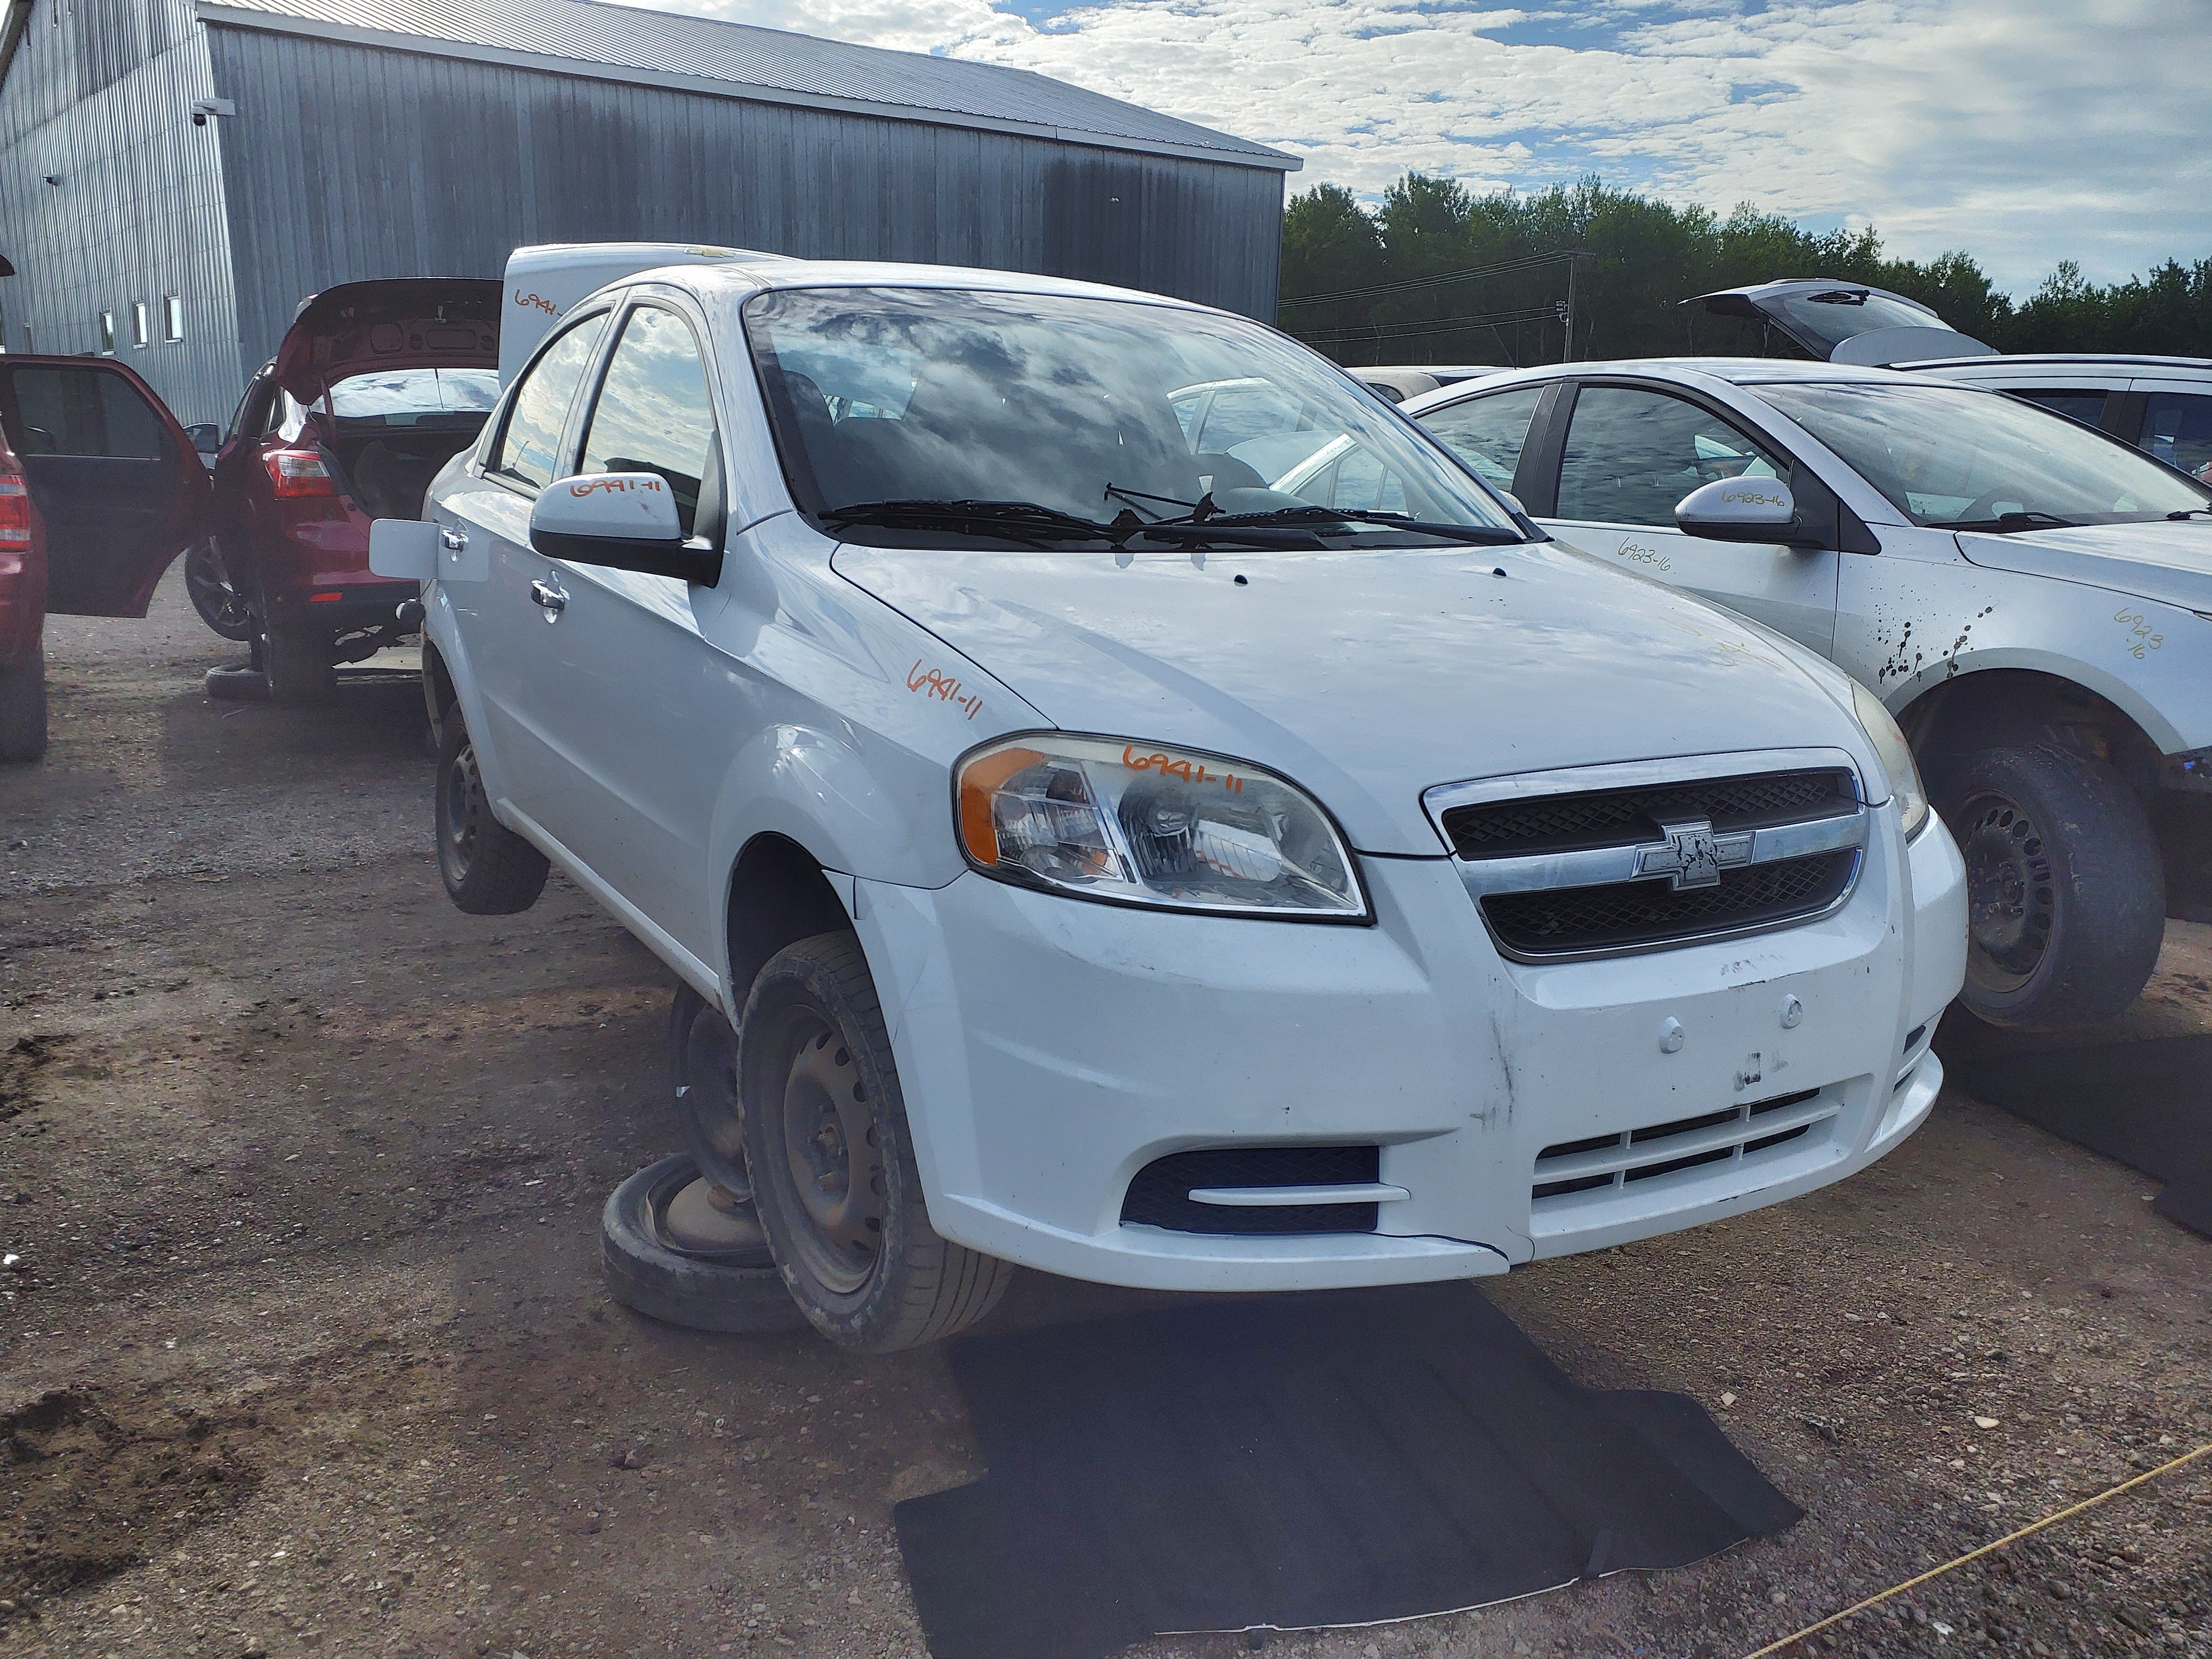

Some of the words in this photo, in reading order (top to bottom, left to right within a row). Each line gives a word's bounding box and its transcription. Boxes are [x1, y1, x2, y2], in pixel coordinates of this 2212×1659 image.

[1721, 489, 1785, 507] 6923-16
[1618, 536, 1671, 571] 6923-16
[2113, 607, 2164, 649] 6923
[907, 659, 983, 719] 6941-11
[1122, 744, 1243, 793] 6941-11
